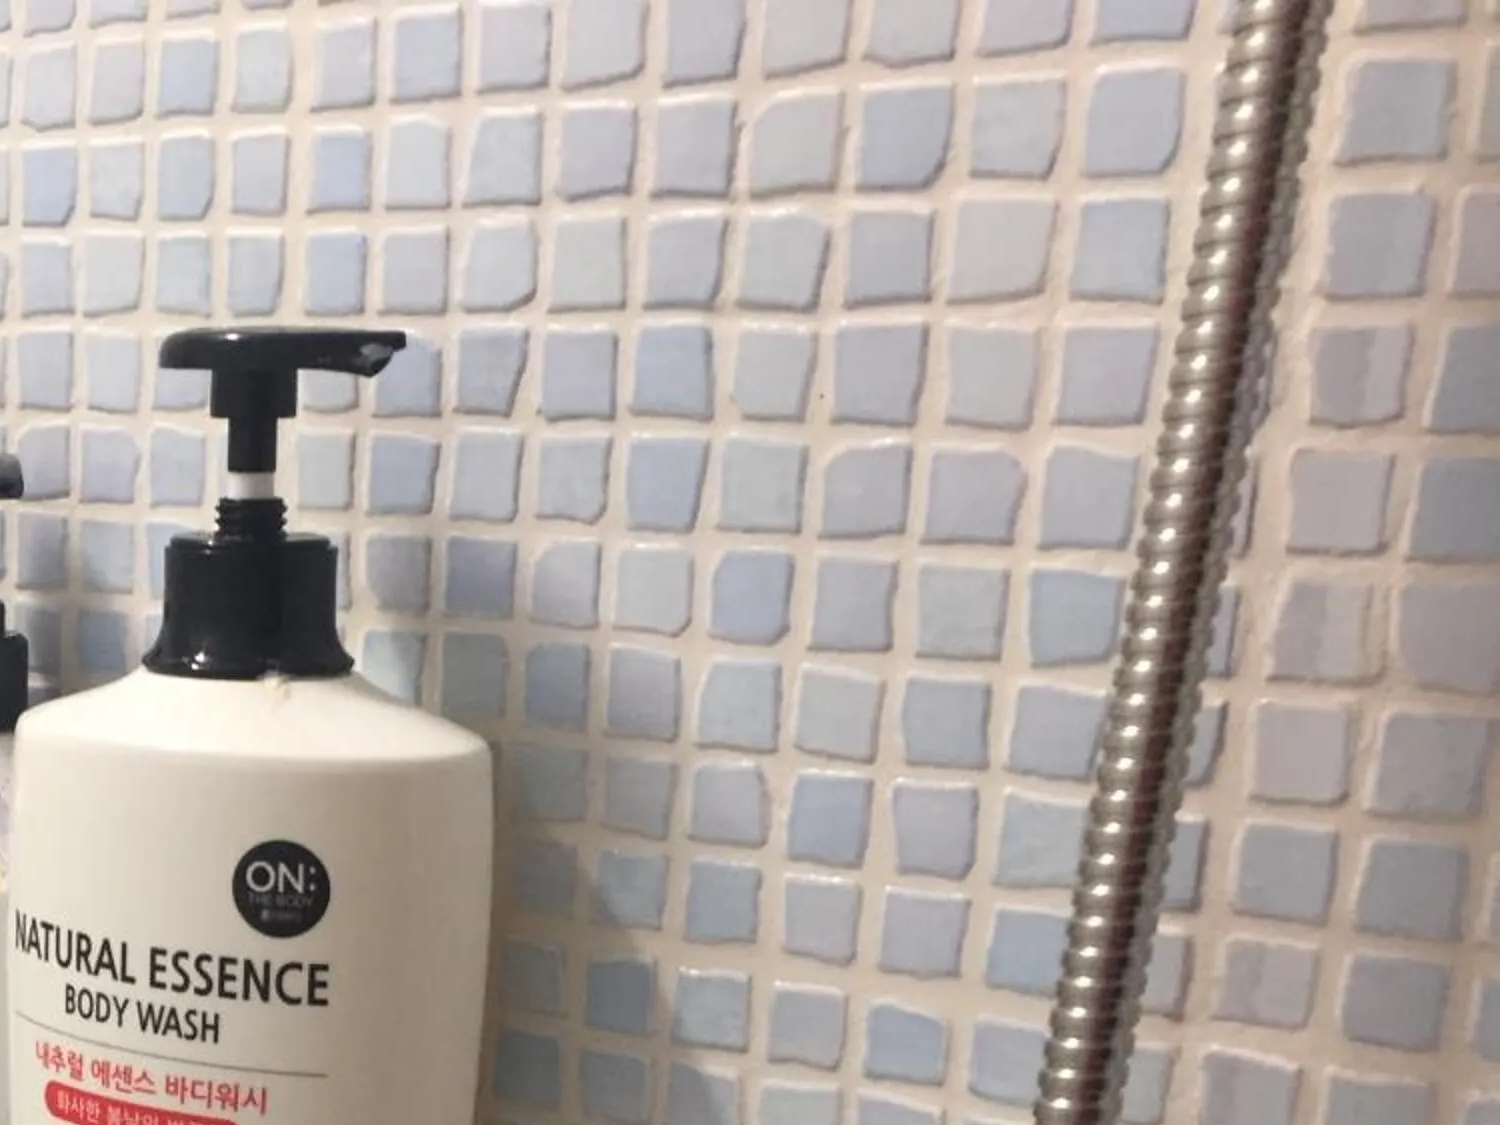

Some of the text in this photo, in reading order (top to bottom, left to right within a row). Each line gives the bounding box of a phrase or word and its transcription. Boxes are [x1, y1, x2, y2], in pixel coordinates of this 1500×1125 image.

[15, 909, 330, 1007] NATURAL ESSENCE
[65, 984, 221, 1045] BODY WASH
[35, 1040, 268, 1116] 내추럴 에센스 바디워시
[56, 1090, 100, 1124] 화사한
